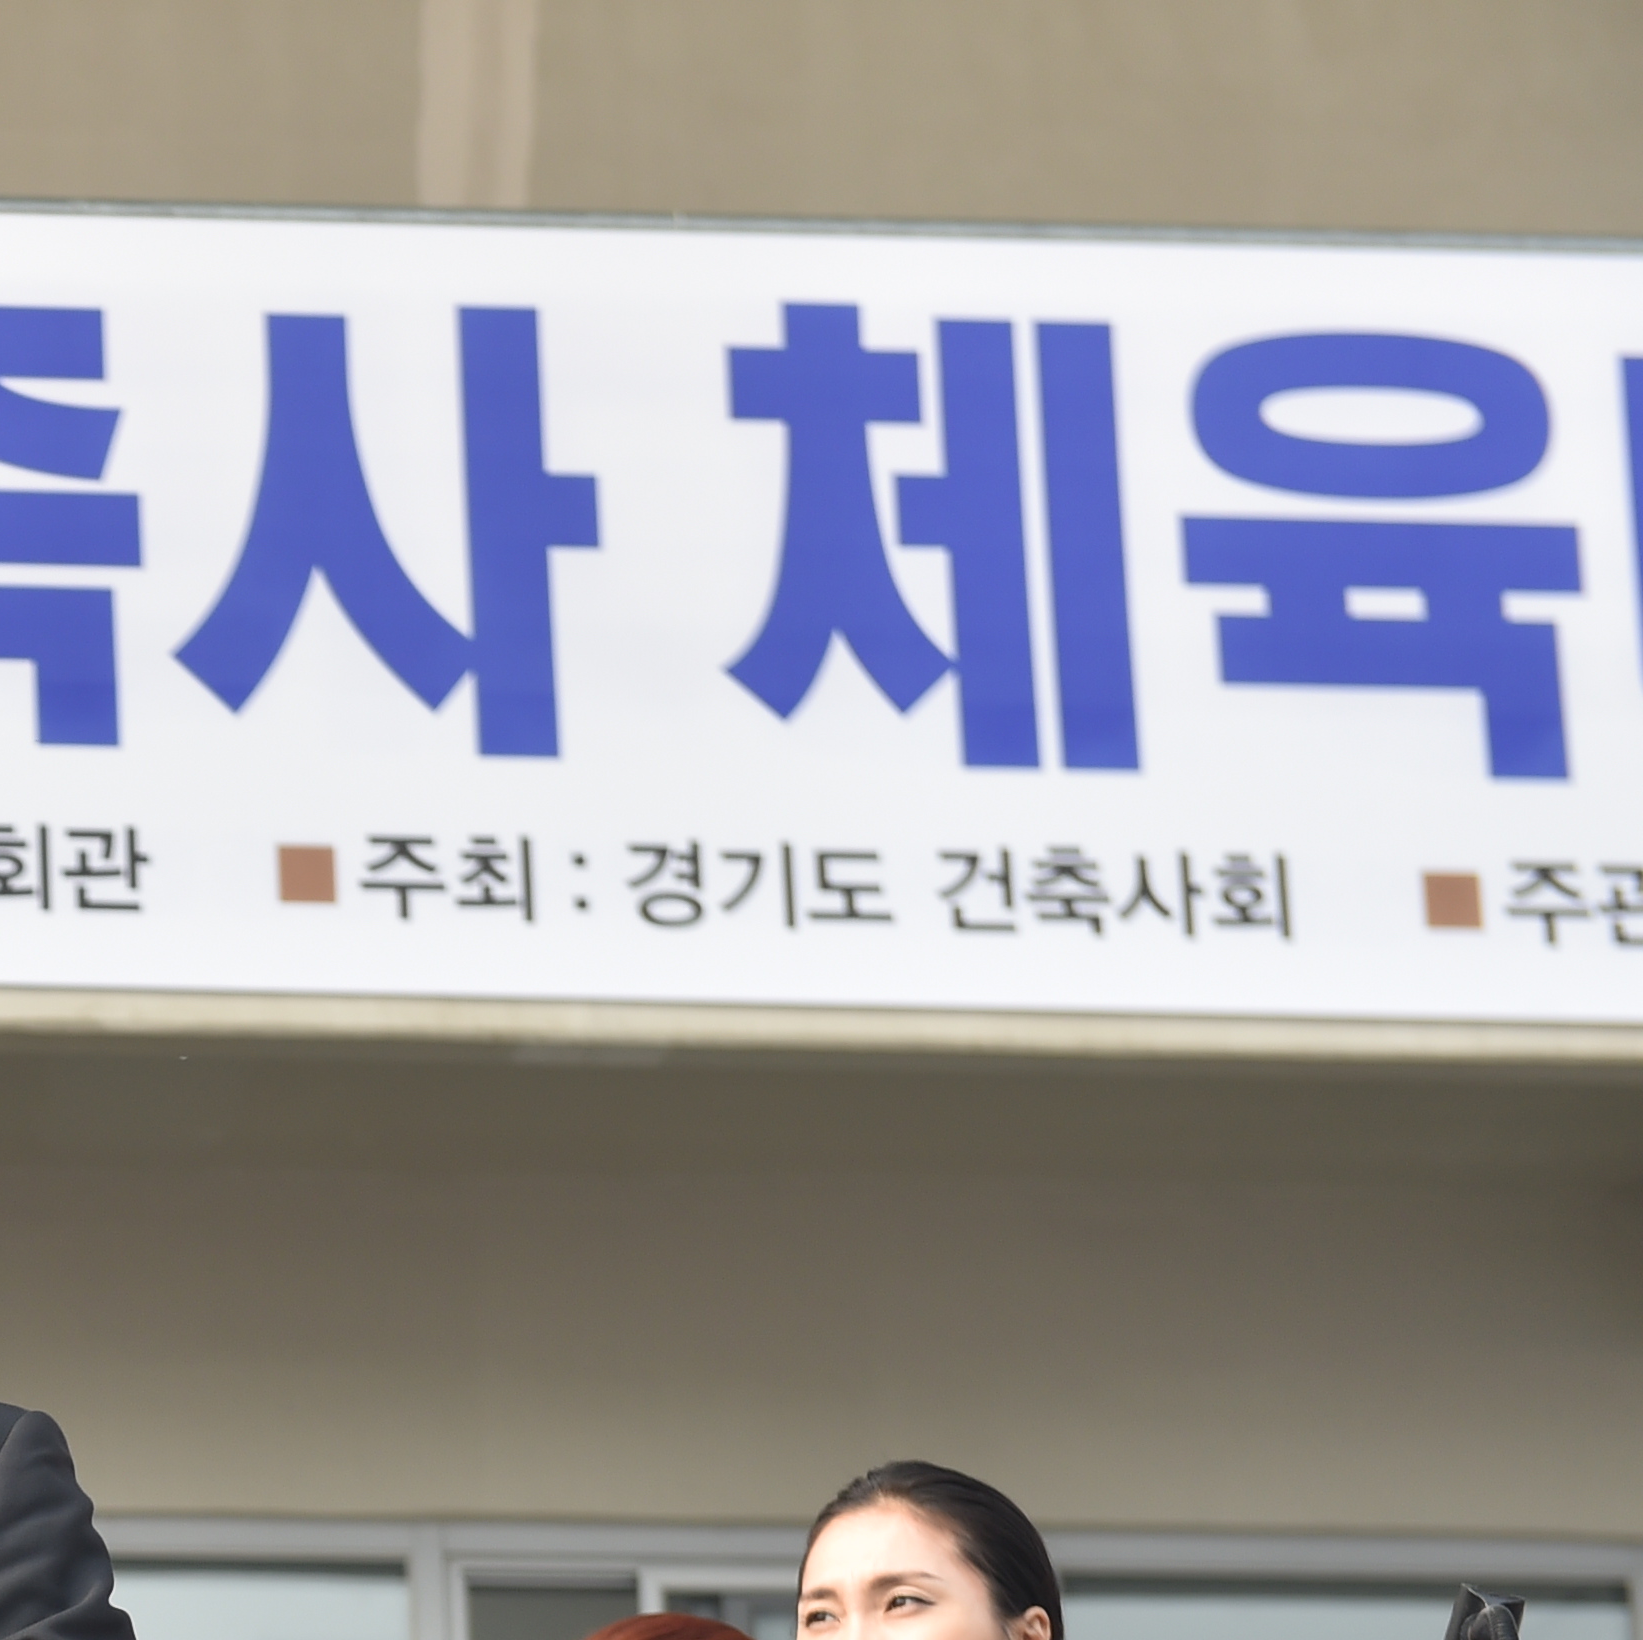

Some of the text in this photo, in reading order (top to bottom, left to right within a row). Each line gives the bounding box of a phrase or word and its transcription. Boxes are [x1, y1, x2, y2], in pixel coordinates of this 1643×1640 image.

[725, 302, 1643, 782] 체육
[361, 836, 533, 922] 주최
[629, 841, 892, 928] 경기도
[940, 848, 1291, 939] 건축사회
